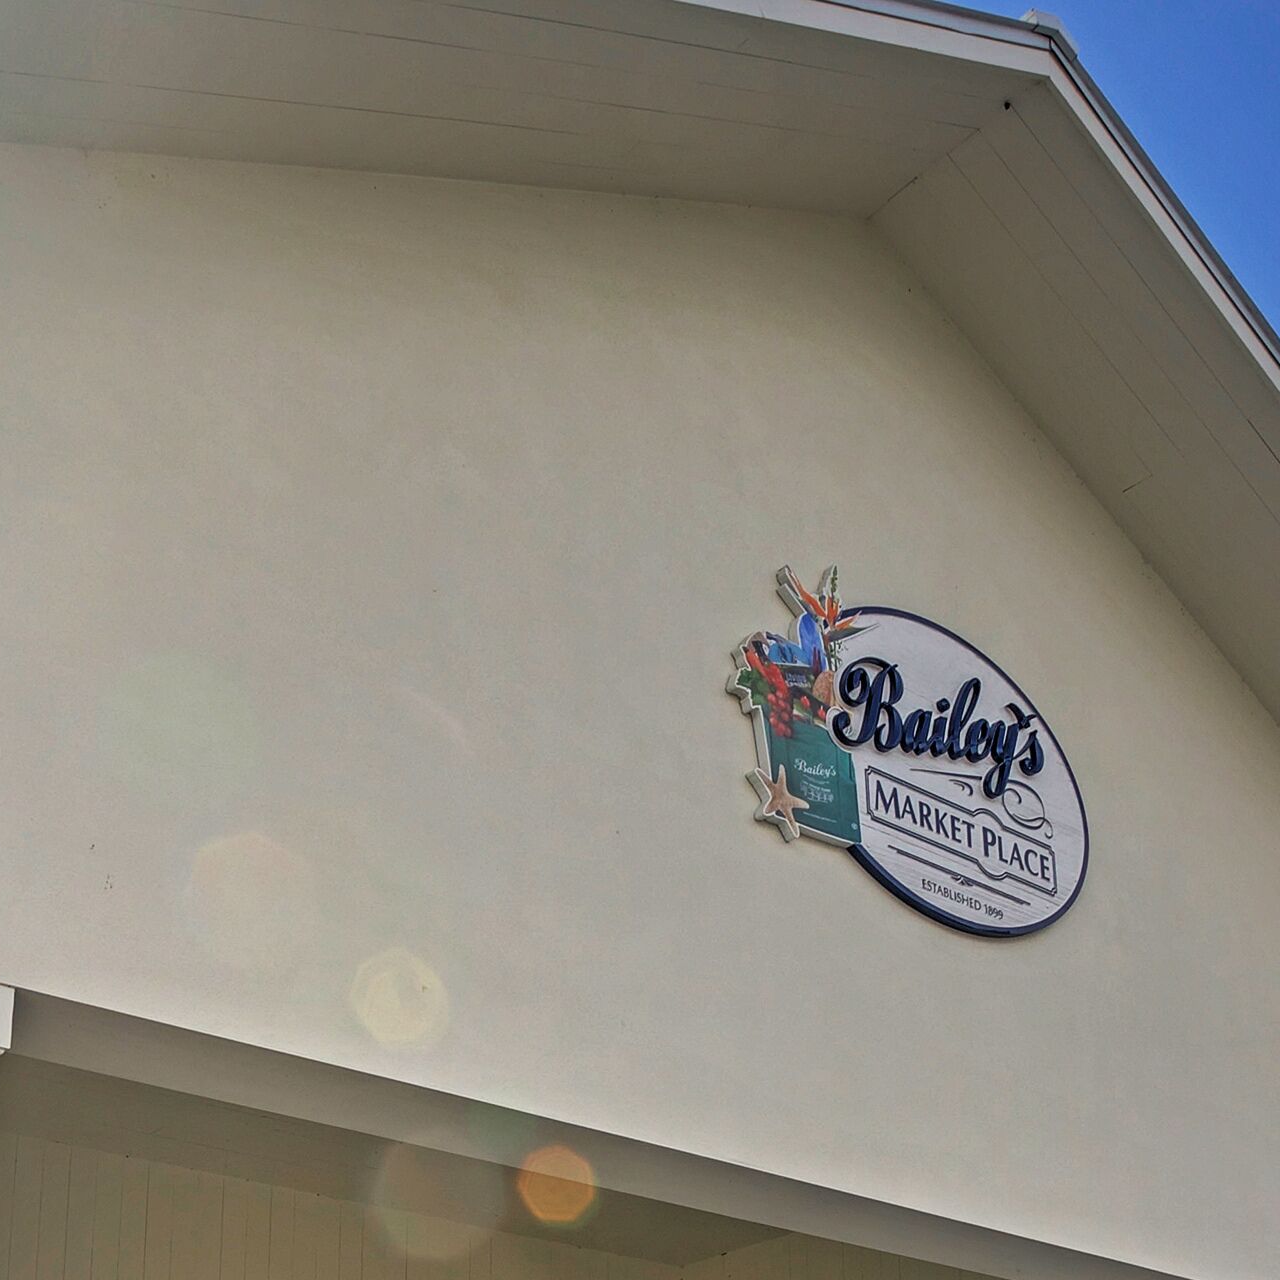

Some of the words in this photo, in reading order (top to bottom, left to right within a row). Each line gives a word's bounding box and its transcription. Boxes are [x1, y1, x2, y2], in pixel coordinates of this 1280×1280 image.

[832, 657, 1044, 799] Bailey's
[794, 758, 837, 779] Bailey's
[874, 780, 975, 849] MARKET
[982, 826, 1051, 882] PLACE
[921, 878, 982, 911] ESTABLISHED
[984, 904, 1004, 920] 1899
